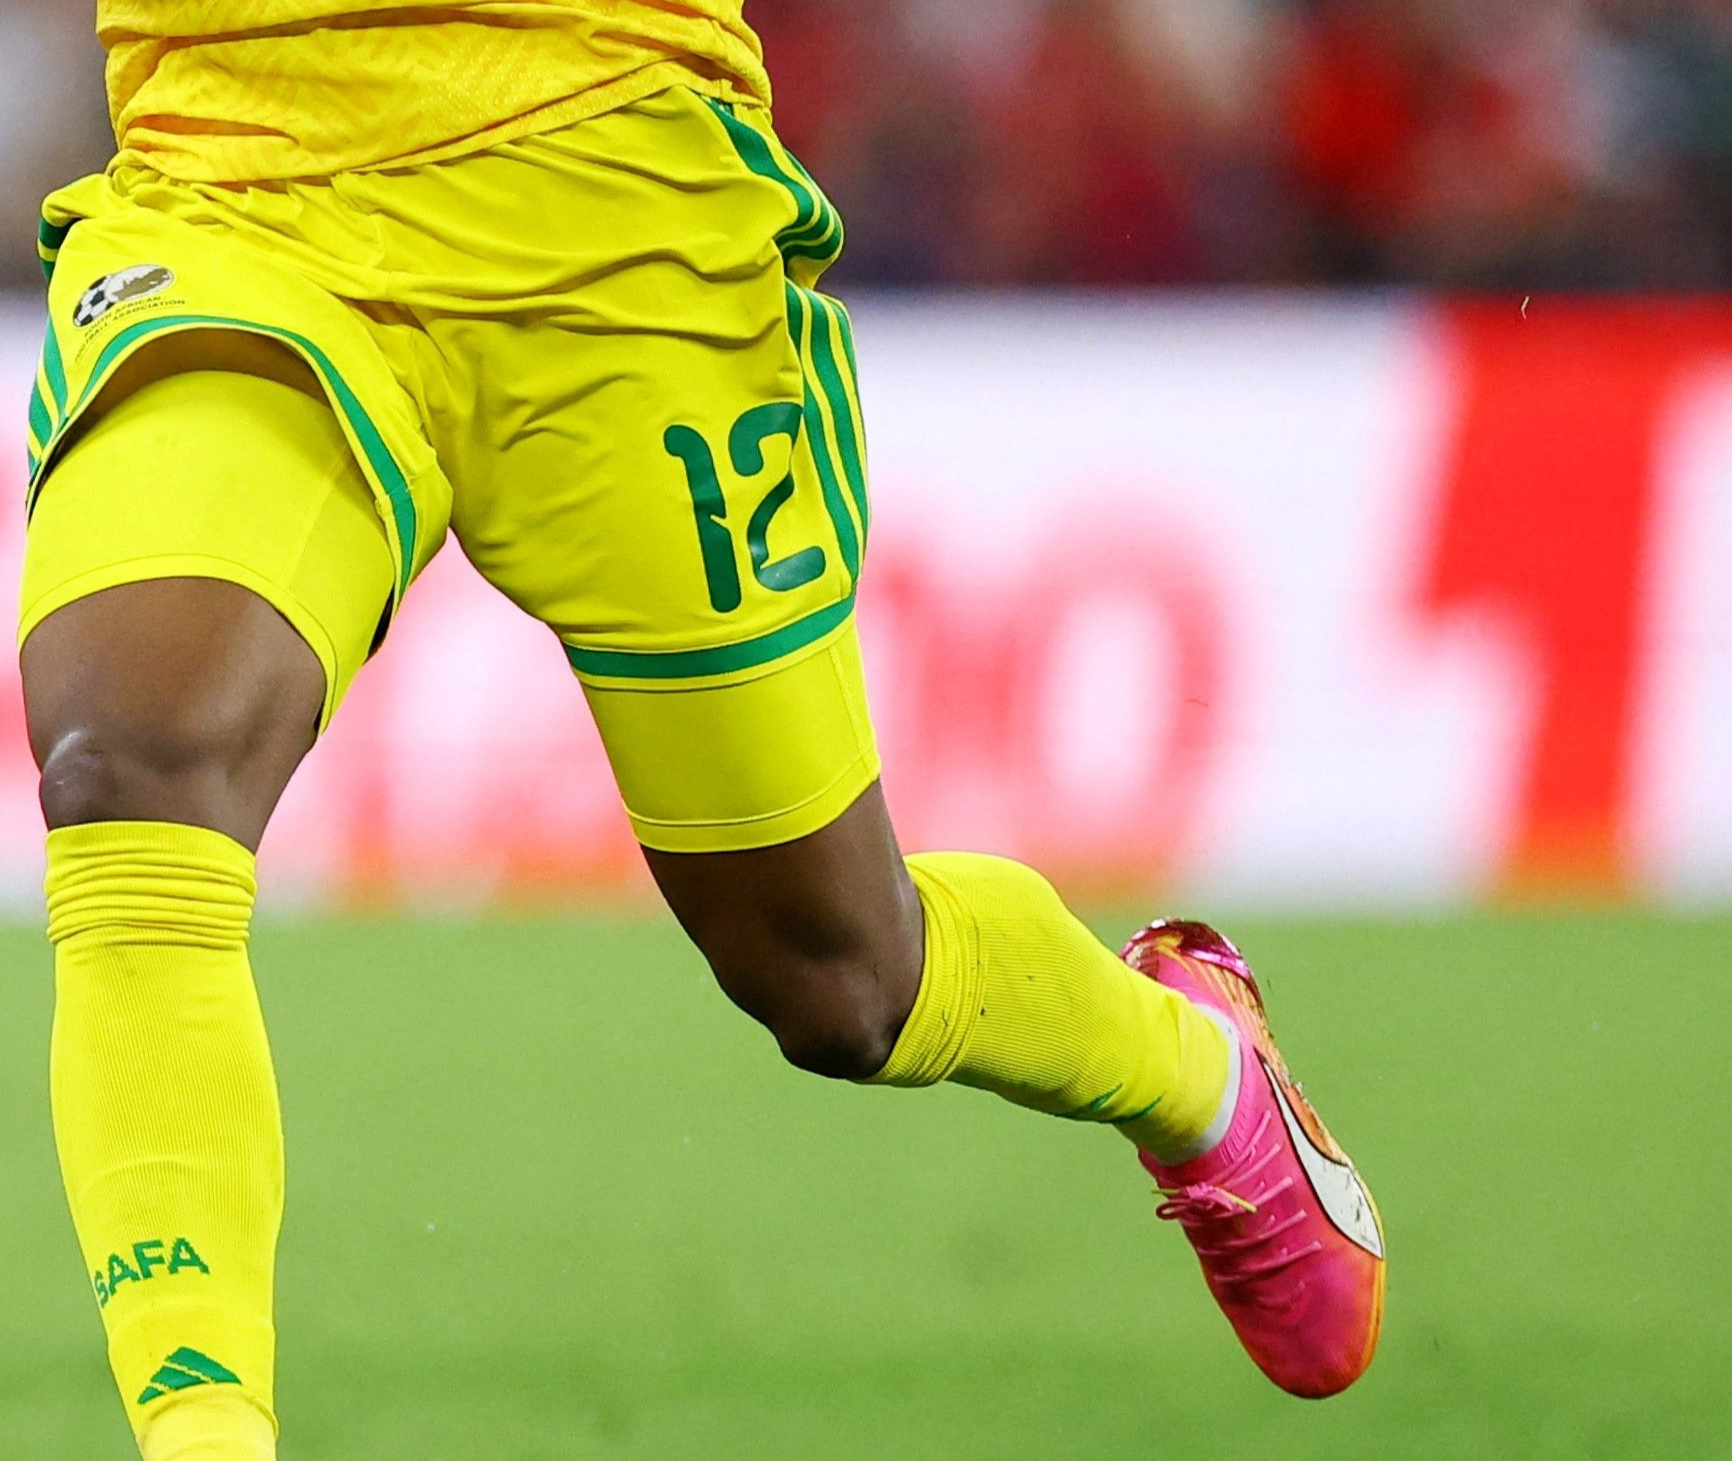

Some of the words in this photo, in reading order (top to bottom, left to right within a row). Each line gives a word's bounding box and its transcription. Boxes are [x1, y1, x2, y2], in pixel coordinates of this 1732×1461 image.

[84, 313, 112, 337] SOUTH
[115, 296, 161, 314] AFRICAN
[112, 300, 186, 322] ASSOCIATION
[663, 401, 826, 614] 12
[93, 1237, 211, 1308] SAFA
